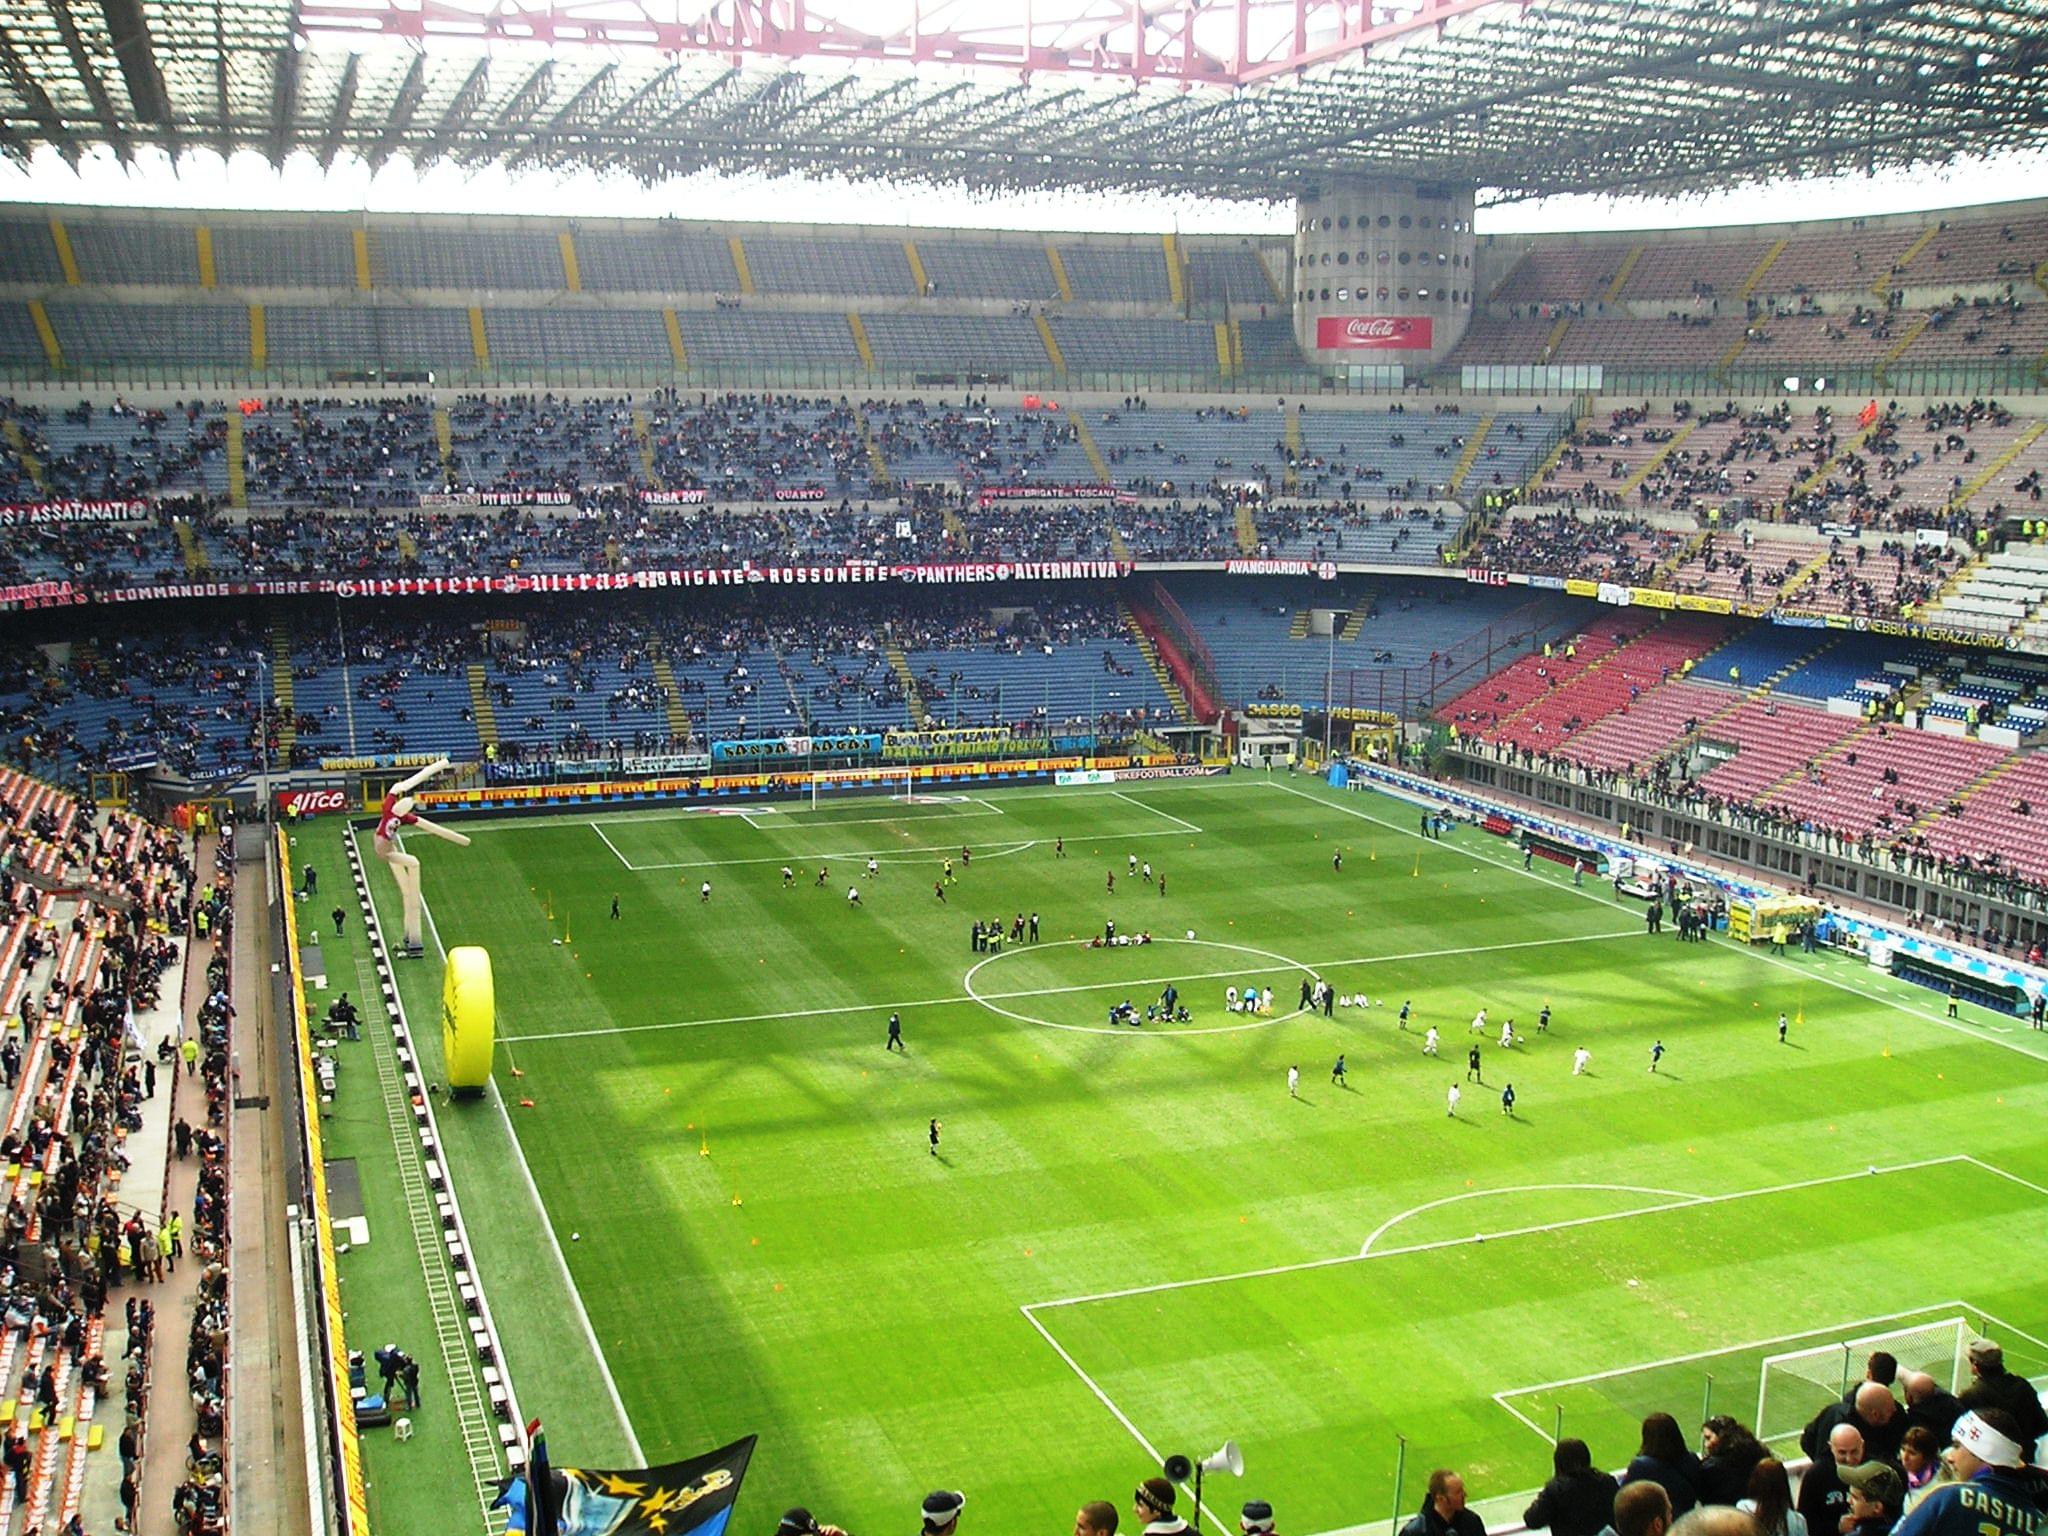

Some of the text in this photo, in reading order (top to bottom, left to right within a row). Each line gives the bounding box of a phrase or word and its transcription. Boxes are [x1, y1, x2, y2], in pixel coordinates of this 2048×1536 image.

[776, 490, 824, 501] QUARTO
[1074, 488, 1115, 498] TOSCANA
[31, 502, 128, 522] ASSATANATI
[657, 566, 888, 586] BRIGATE ROSSONERE
[917, 561, 1118, 583] PANTHERS ALTERNATIVA
[1227, 560, 1311, 575] AVANGUARDIA
[114, 581, 311, 602] COMMANDOS TIGRE
[1869, 618, 1909, 636] NEBBIA
[1921, 626, 2004, 648] NERAZZURRA
[1960, 1486, 2043, 1535] CASTIL
